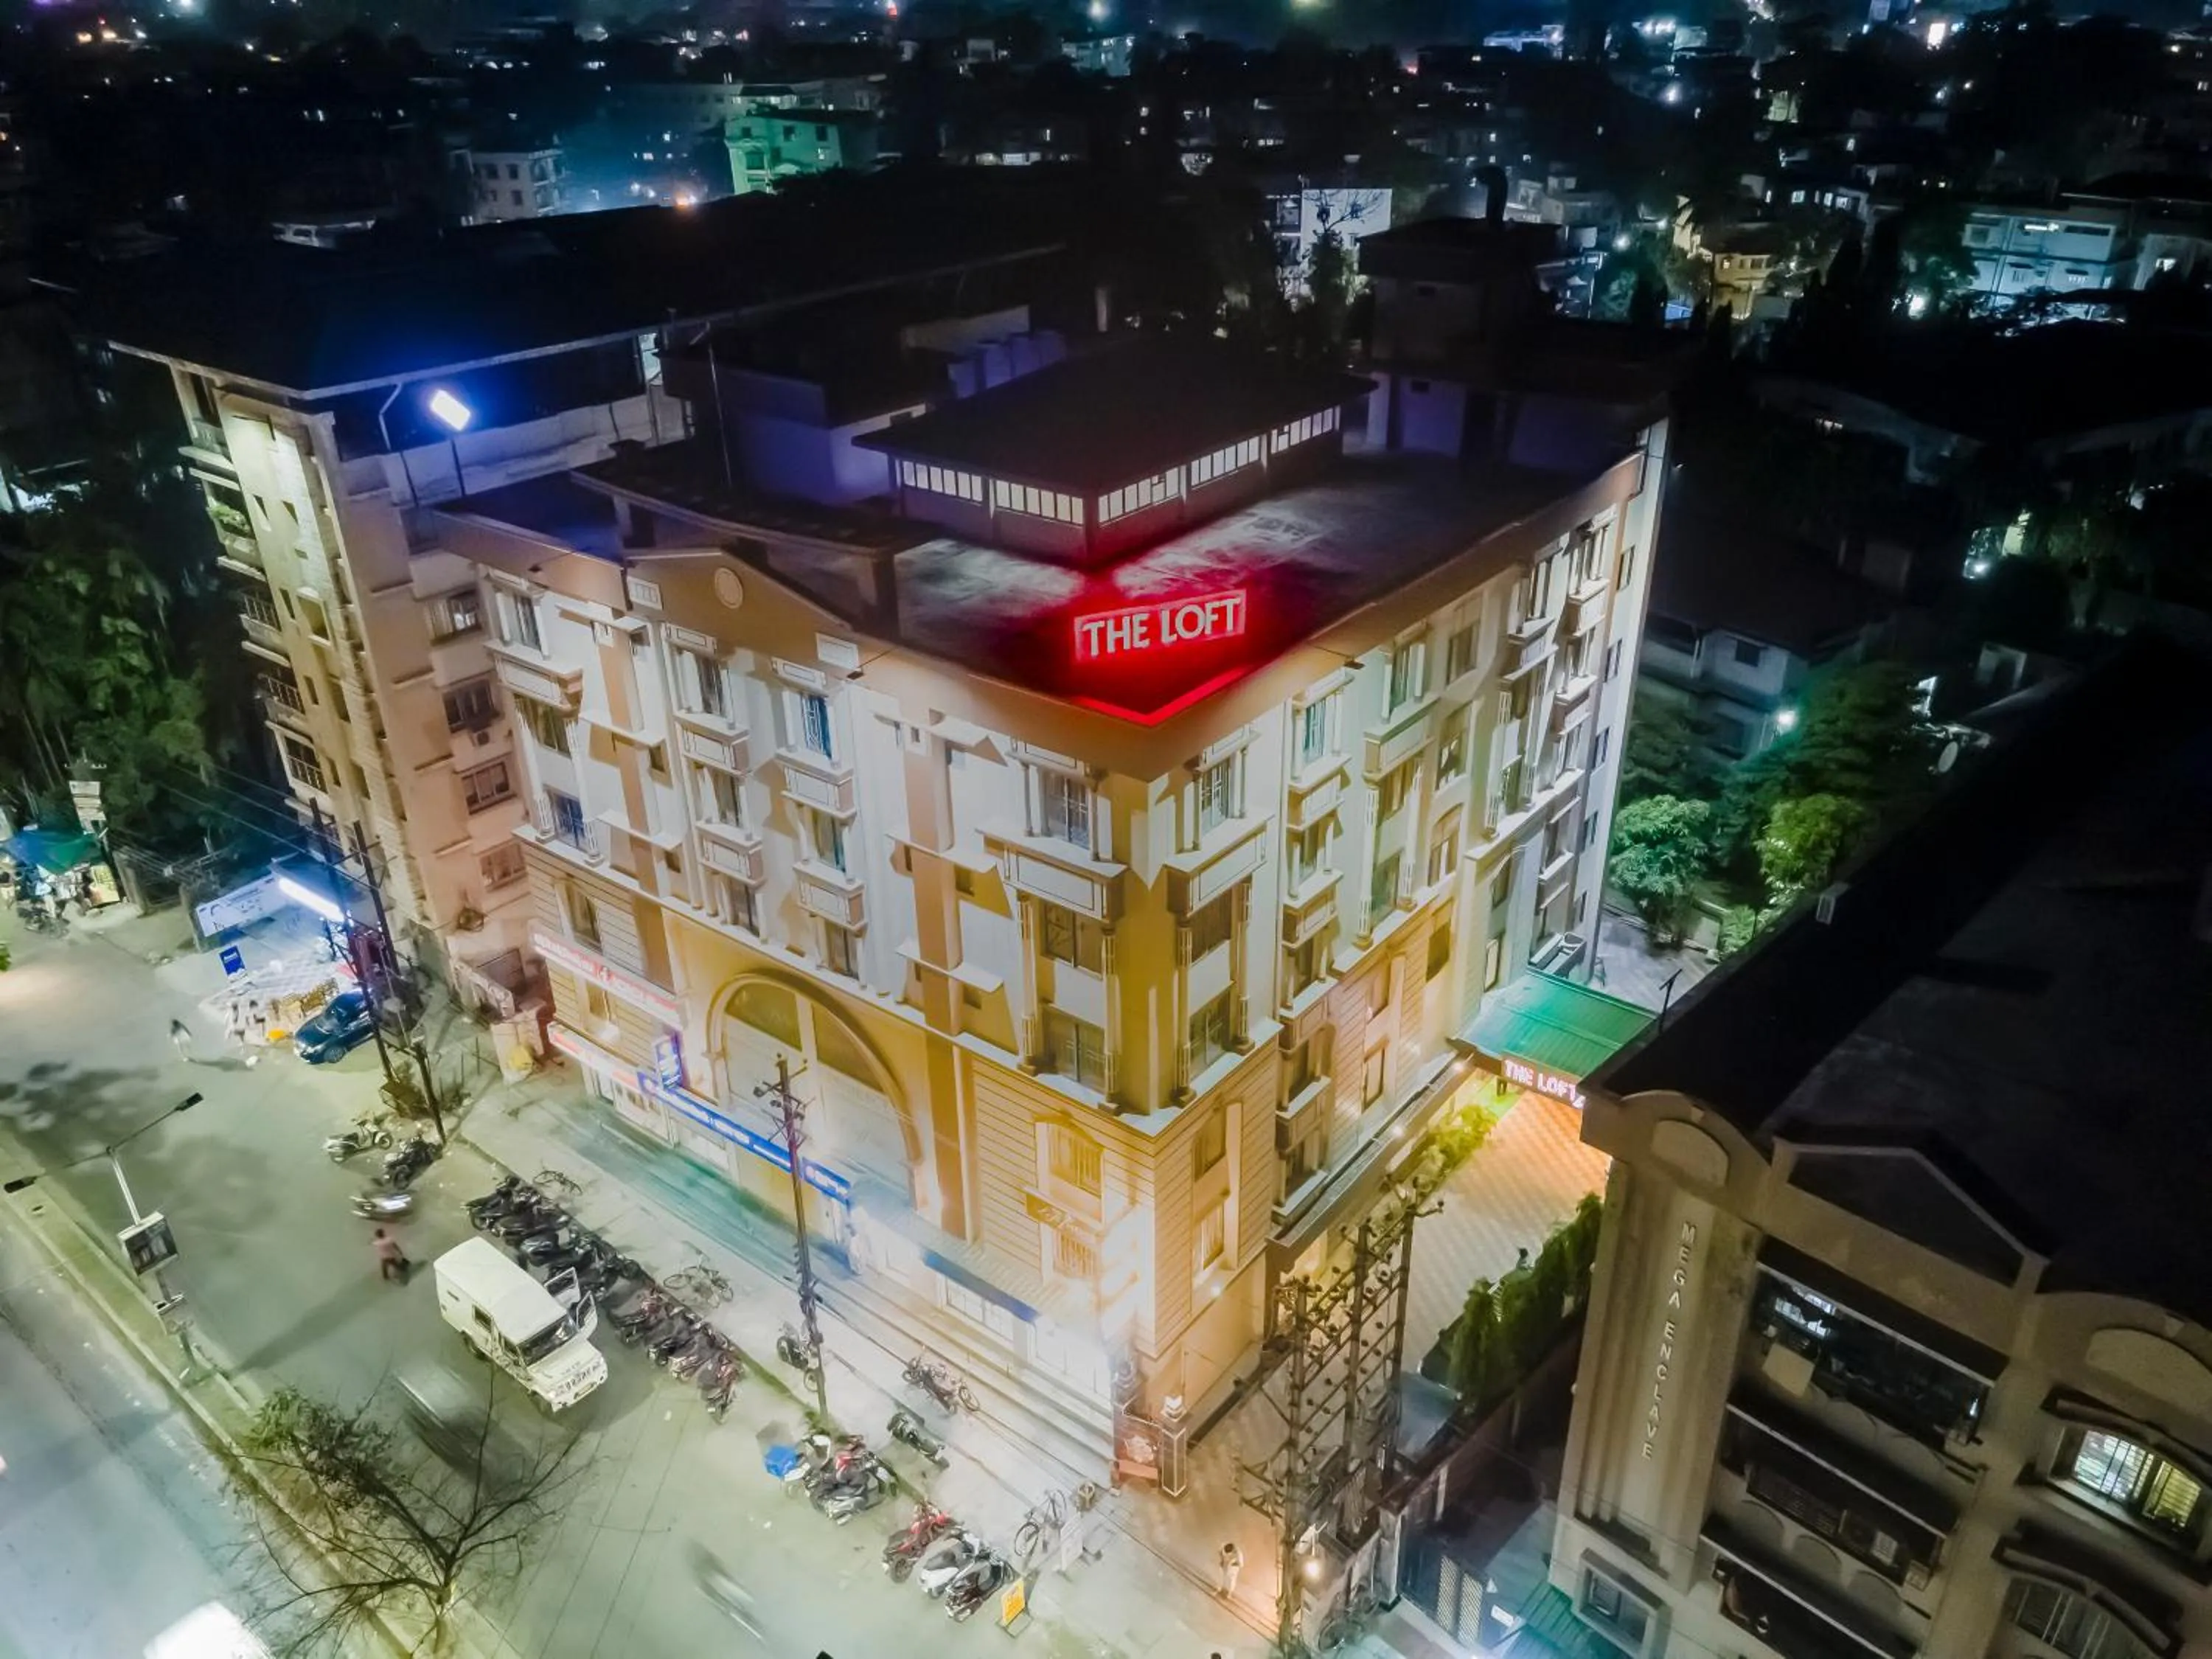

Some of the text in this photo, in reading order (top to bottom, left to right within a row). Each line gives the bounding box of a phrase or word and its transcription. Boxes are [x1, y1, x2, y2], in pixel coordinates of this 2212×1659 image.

[1082, 598, 1241, 656] THE LOFT
[1504, 1060, 1576, 1102] THE LOFT
[1641, 1221, 1697, 1461] MEGA ENCLAVE
